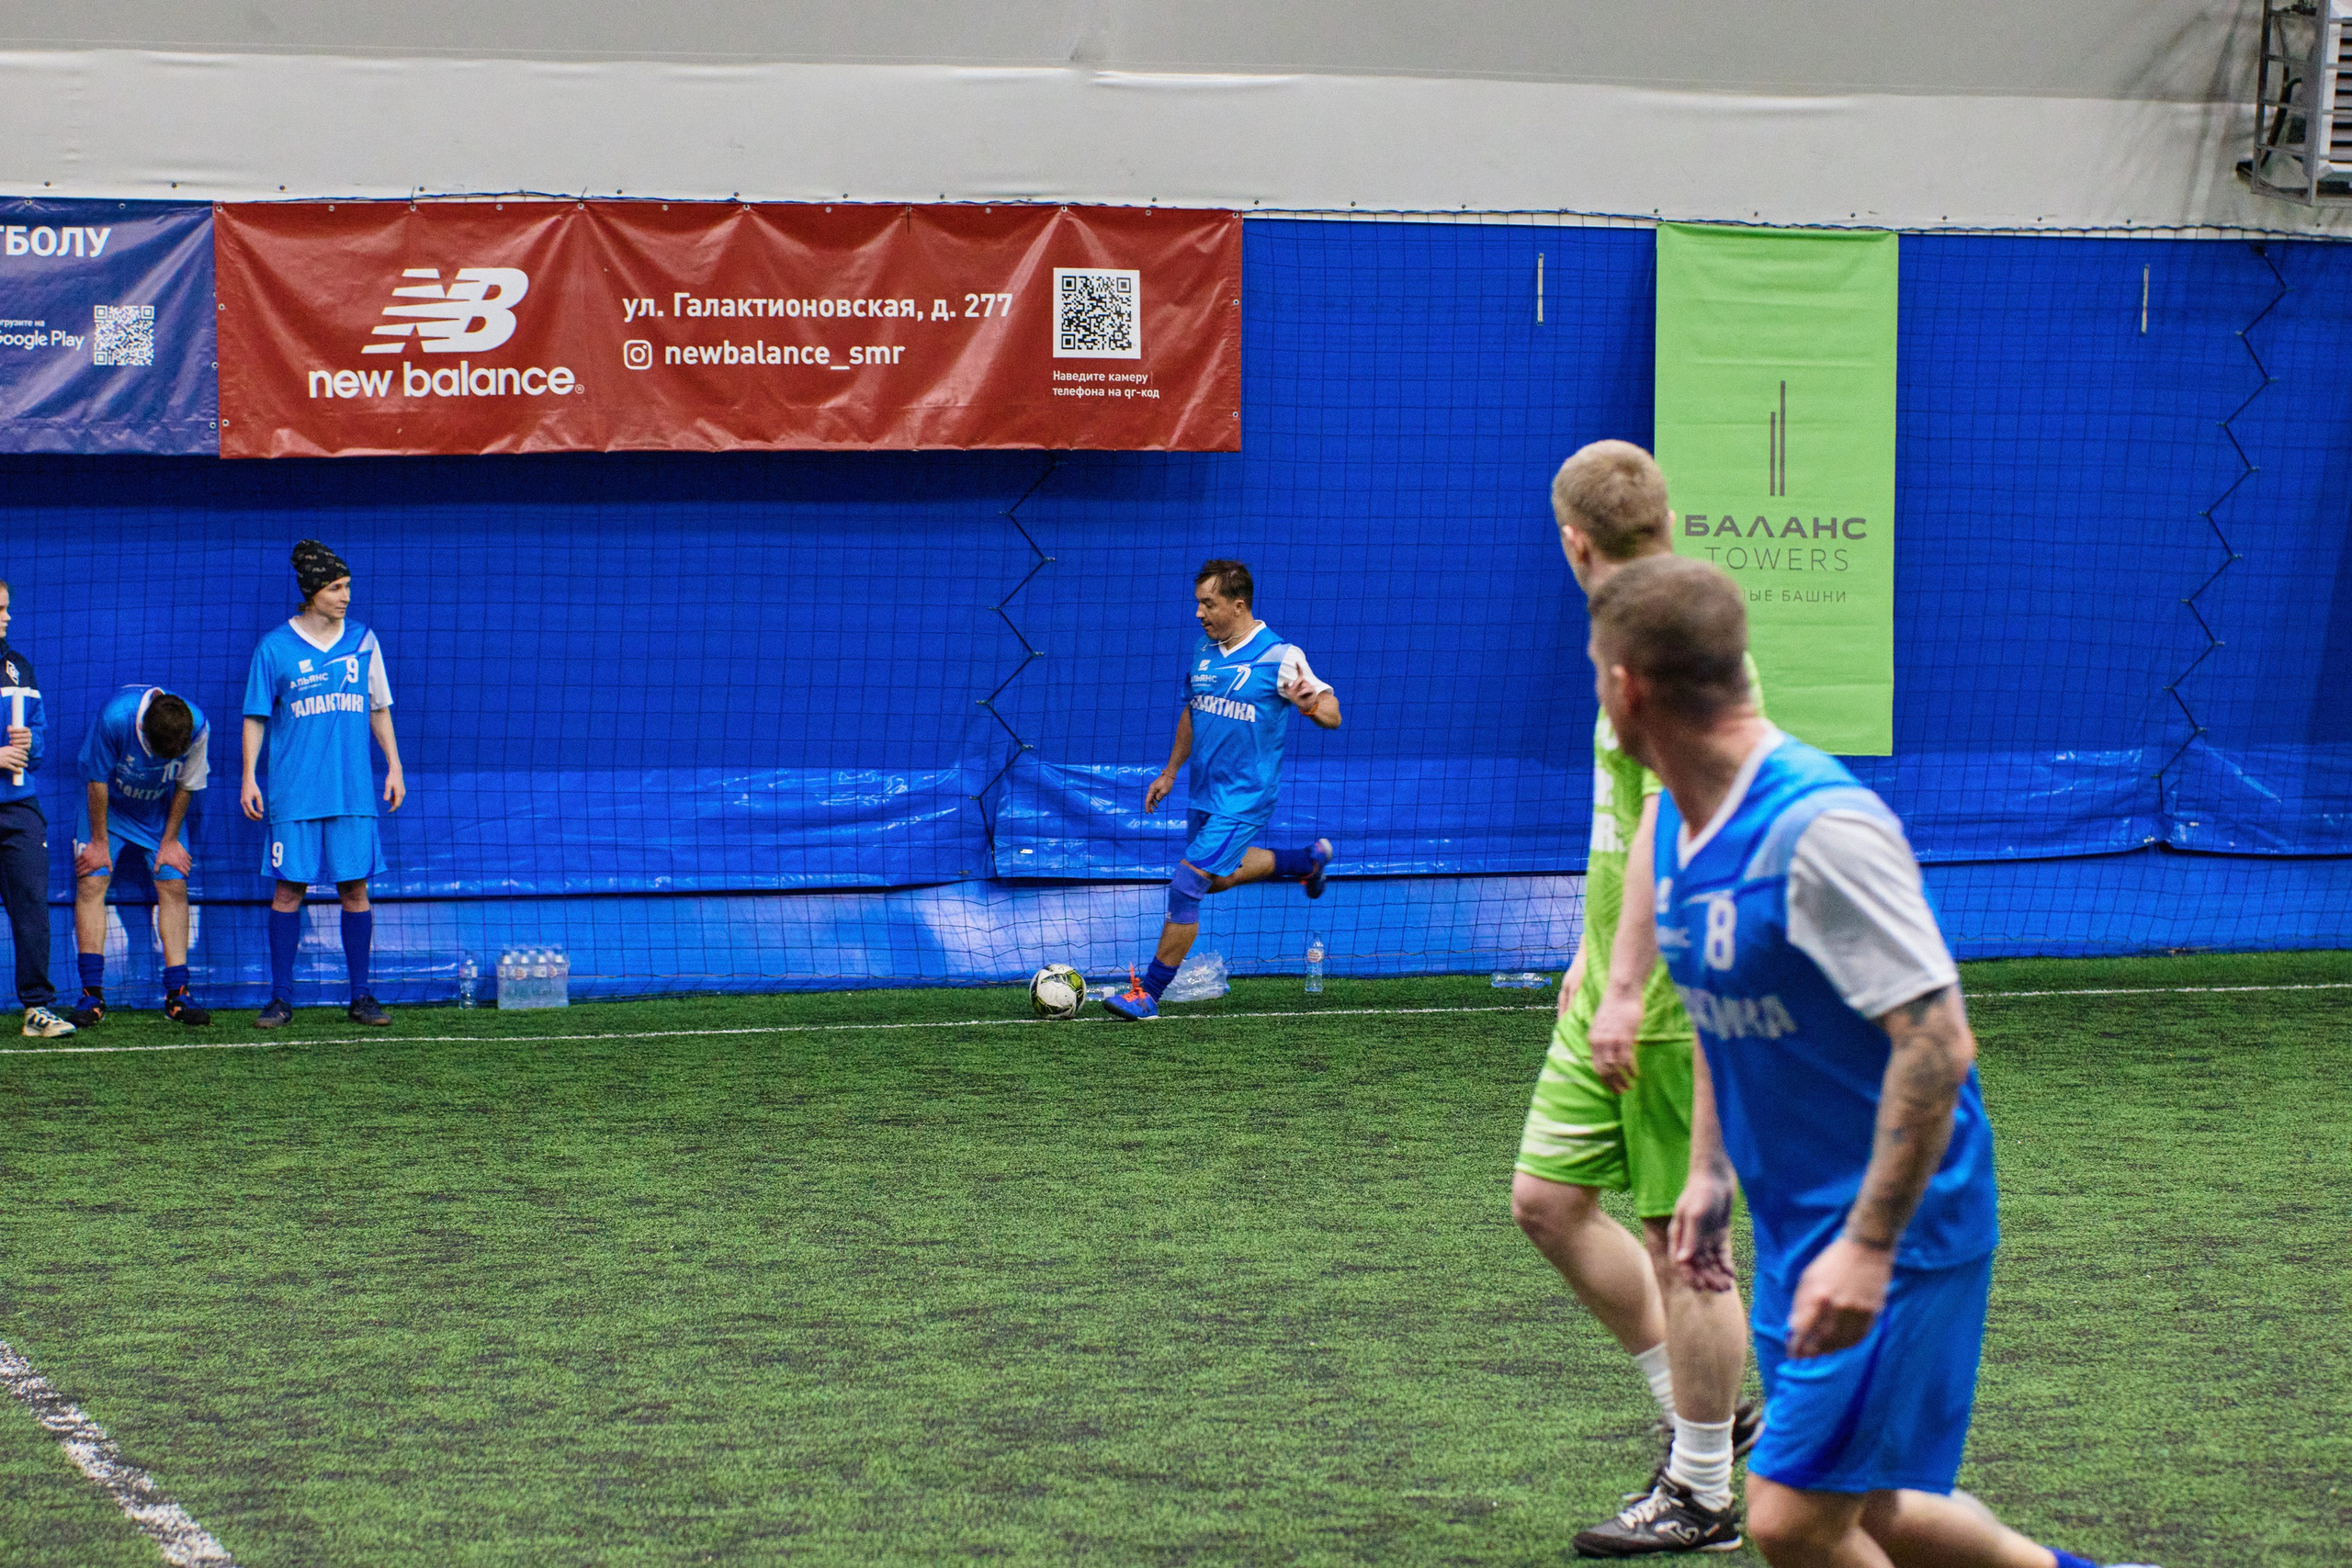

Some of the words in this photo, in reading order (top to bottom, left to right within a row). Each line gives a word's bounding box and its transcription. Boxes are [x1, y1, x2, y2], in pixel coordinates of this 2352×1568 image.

[0, 225, 111, 257] БОЛУ
[622, 297, 664, 322] ул.
[673, 292, 923, 321] Галактионовская,
[931, 298, 956, 321] д.
[965, 293, 1012, 318] 277
[34, 320, 46, 328] на
[51, 331, 85, 352] Play
[664, 340, 906, 370] newbalance_smr
[308, 369, 393, 399] new
[1053, 370, 1105, 382] Наведите
[1108, 373, 1148, 384] камеру
[1053, 386, 1104, 398] телефона
[1108, 389, 1122, 397] на
[1124, 389, 1160, 400] qr-код
[1684, 514, 1868, 540] БАЛАНС
[1704, 547, 1849, 571] TOWERS
[1781, 590, 1847, 603] БАШНИ
[345, 657, 359, 683] 9
[1233, 664, 1252, 692] 7
[272, 841, 284, 868] 9
[1705, 897, 1737, 971] 8
